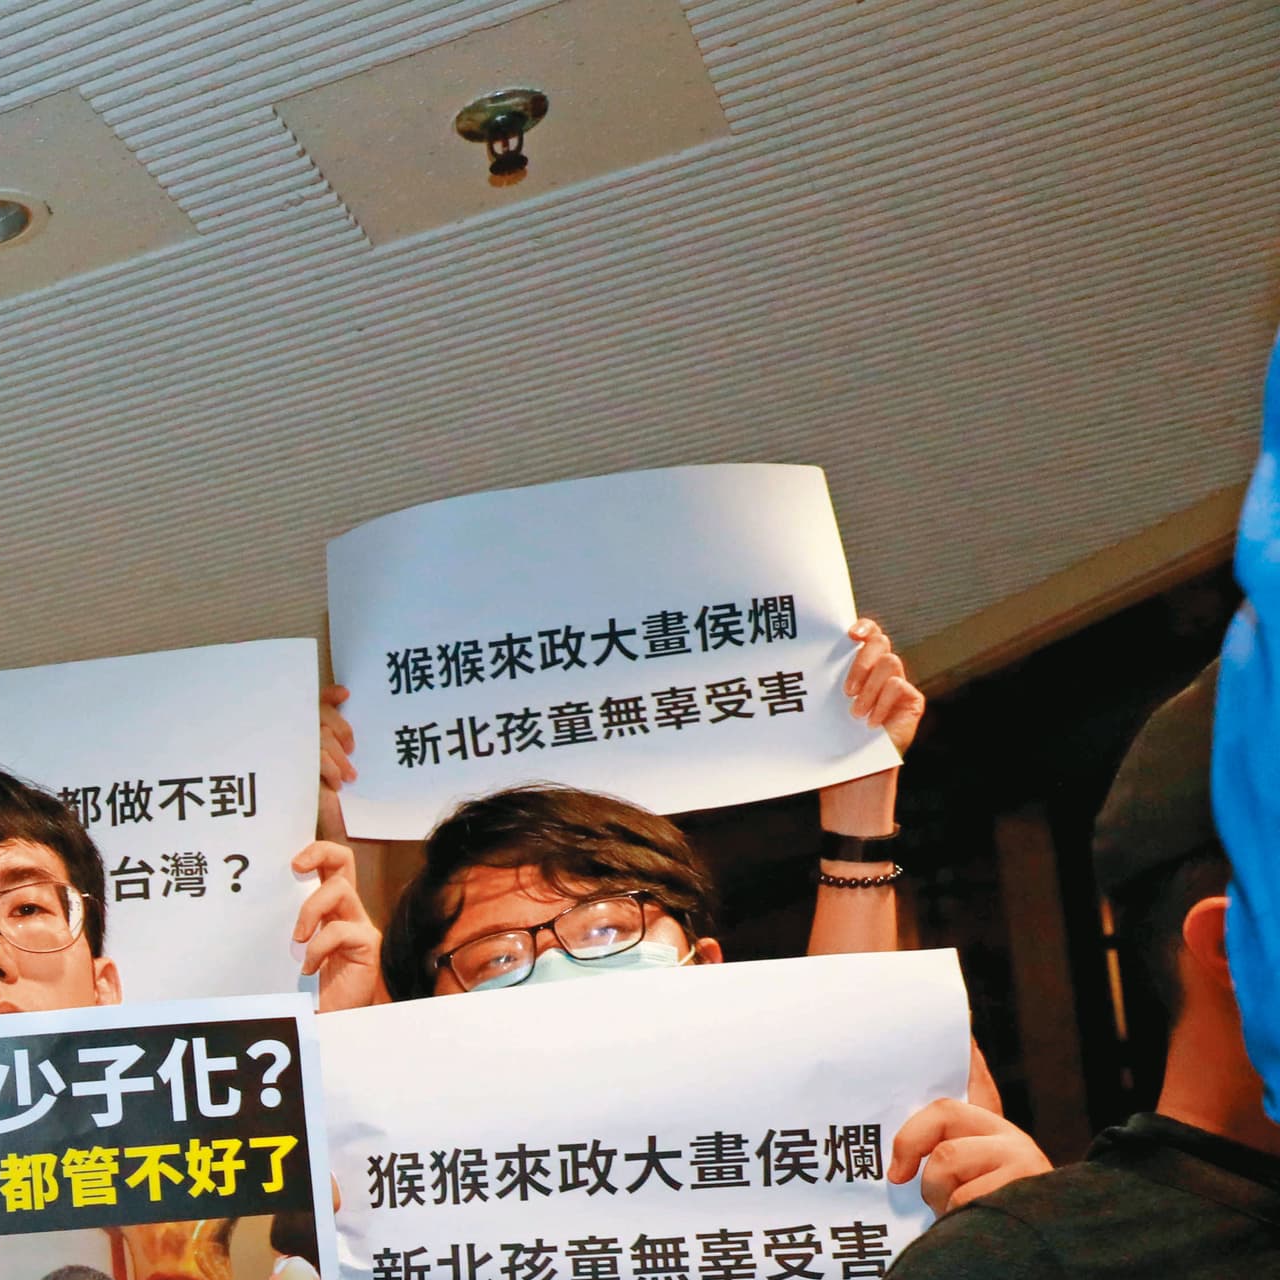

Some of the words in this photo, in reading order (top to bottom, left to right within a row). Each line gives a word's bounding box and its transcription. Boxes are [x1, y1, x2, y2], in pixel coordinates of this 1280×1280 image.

[386, 594, 798, 695] 猴猴來政大畫侯爛
[394, 671, 809, 768] 新北孩童無辜受害
[57, 772, 256, 829] 都做不到
[110, 851, 249, 901] 台灣？
[367, 1124, 885, 1208] 猴猴來政大畫侯爛
